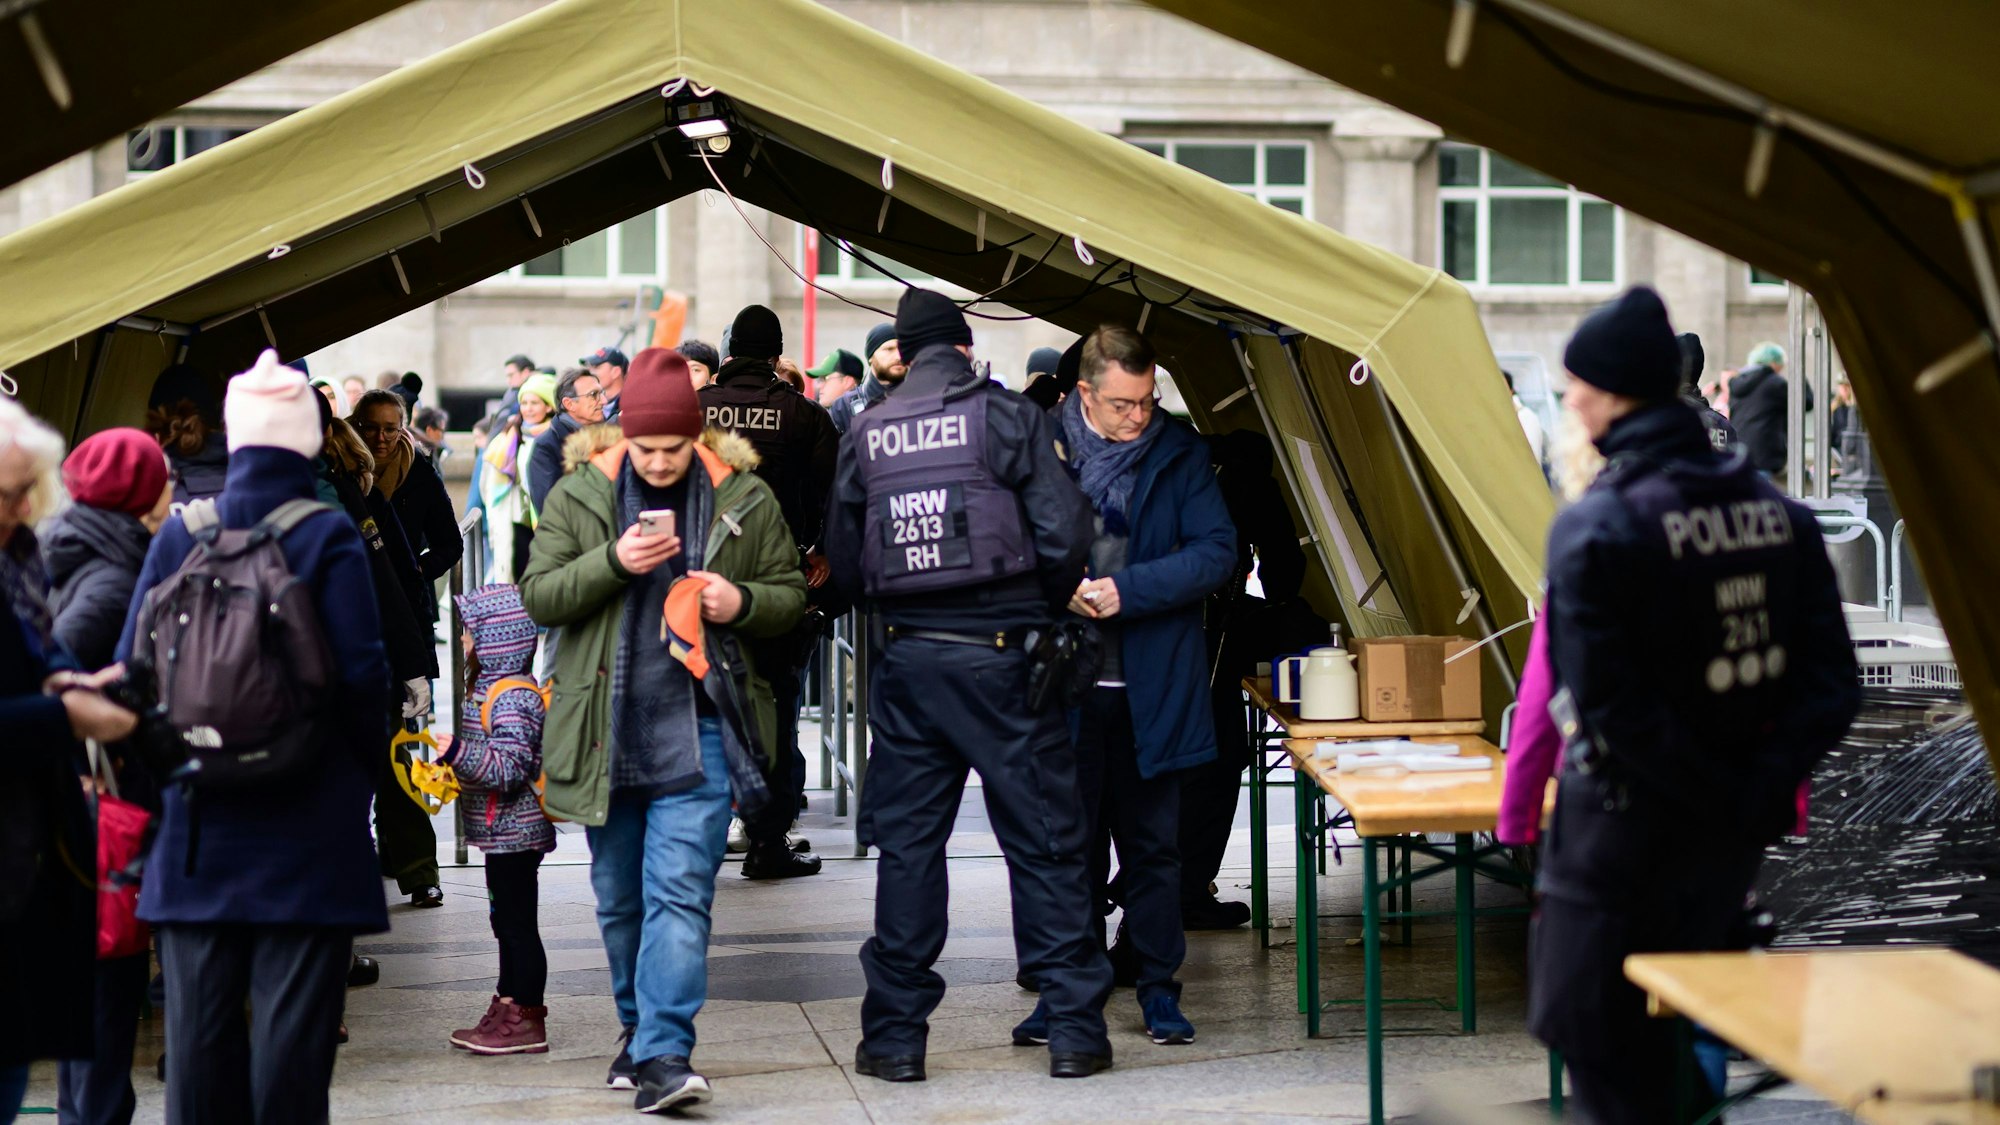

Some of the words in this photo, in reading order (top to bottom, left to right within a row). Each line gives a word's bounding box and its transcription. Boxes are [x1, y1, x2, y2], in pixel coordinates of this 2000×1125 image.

[705, 406, 782, 430] POLIZEI
[866, 414, 968, 462] POLIZEI
[889, 488, 948, 520] NRW
[893, 514, 944, 544] 2613
[1661, 501, 1794, 560] POLIZEI
[905, 543, 942, 571] RH
[1714, 572, 1767, 612] NRW
[1721, 609, 1770, 651] 261
